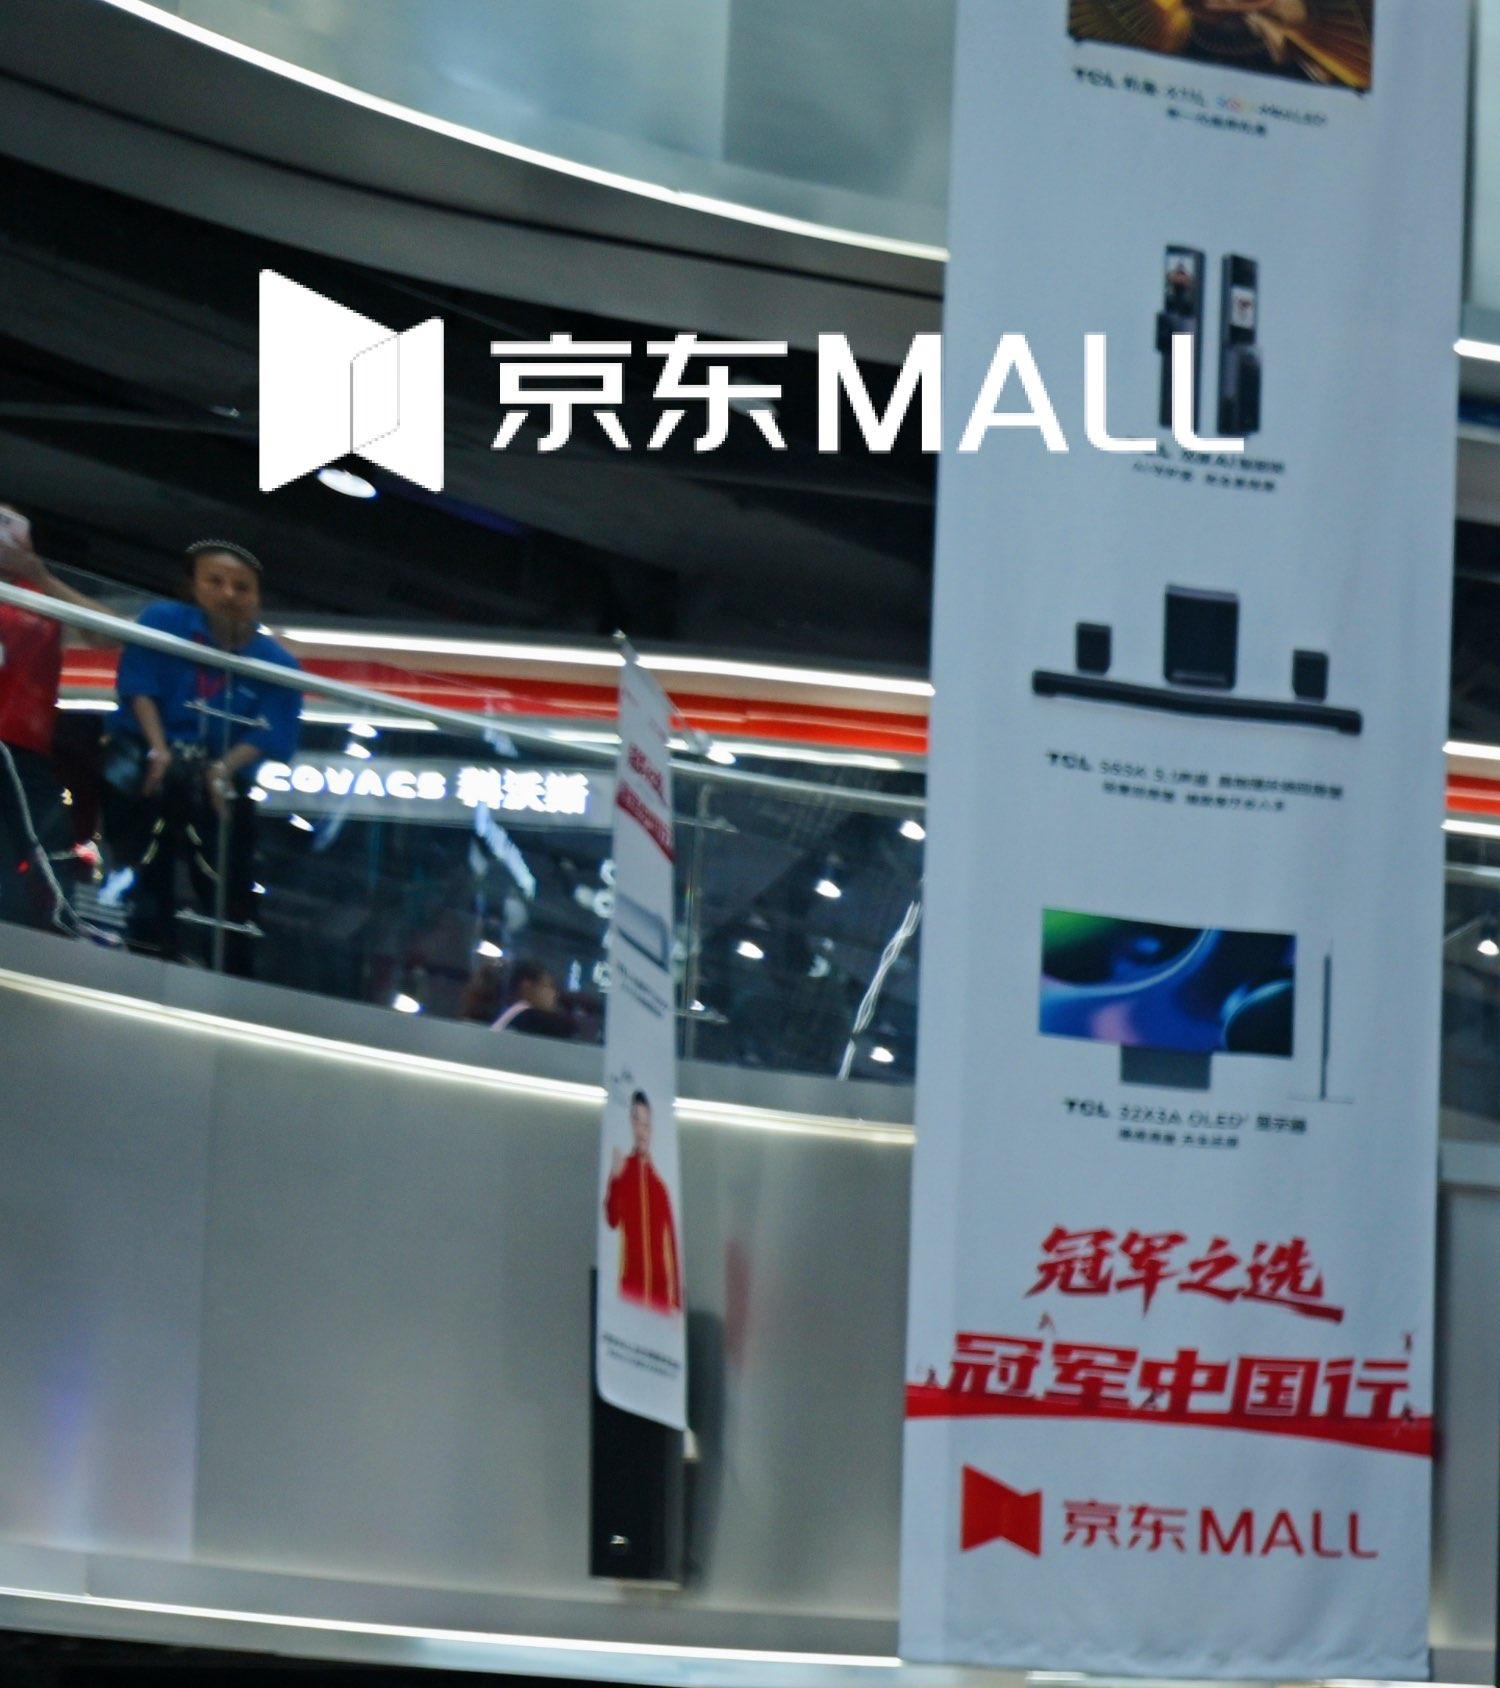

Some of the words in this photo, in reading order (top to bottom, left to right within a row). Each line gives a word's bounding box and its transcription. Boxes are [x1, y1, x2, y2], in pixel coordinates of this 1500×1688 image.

[256, 760, 447, 800] COVACS
[1024, 1225, 1345, 1324] 冠军之选
[944, 1332, 1410, 1421] 冠军中国行
[1063, 1498, 1379, 1559] 京东MALL
